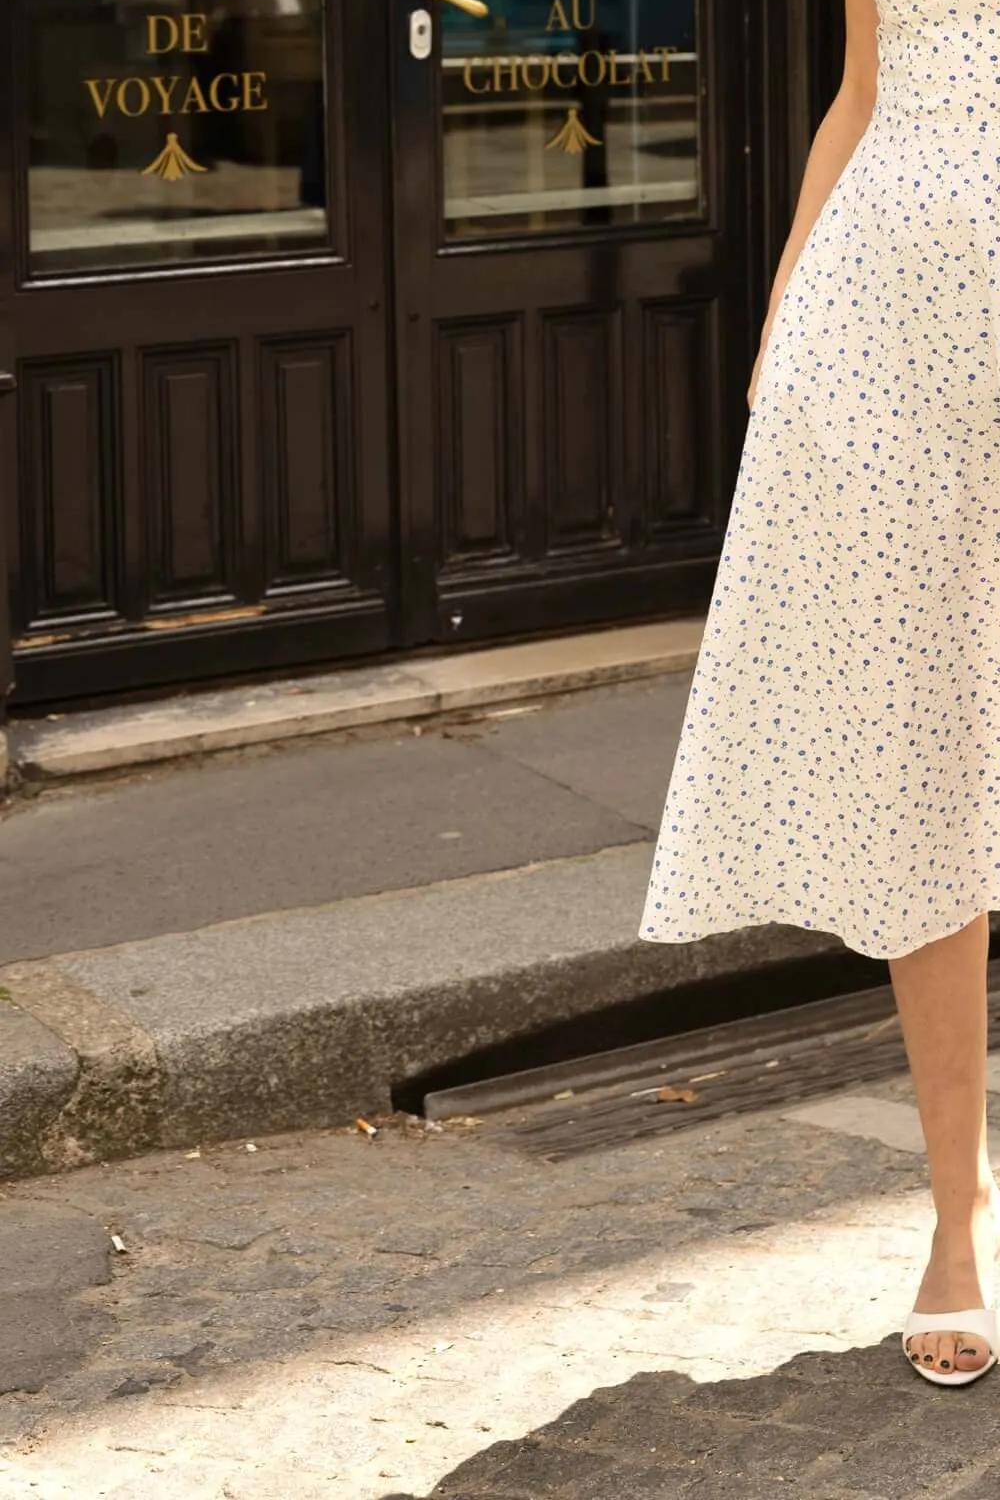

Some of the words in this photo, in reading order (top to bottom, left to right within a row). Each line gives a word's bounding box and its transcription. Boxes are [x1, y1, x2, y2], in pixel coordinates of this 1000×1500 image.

[147, 13, 208, 54] DE
[463, 46, 677, 93] CHOCOLAT
[85, 72, 268, 118] VOYAGE
